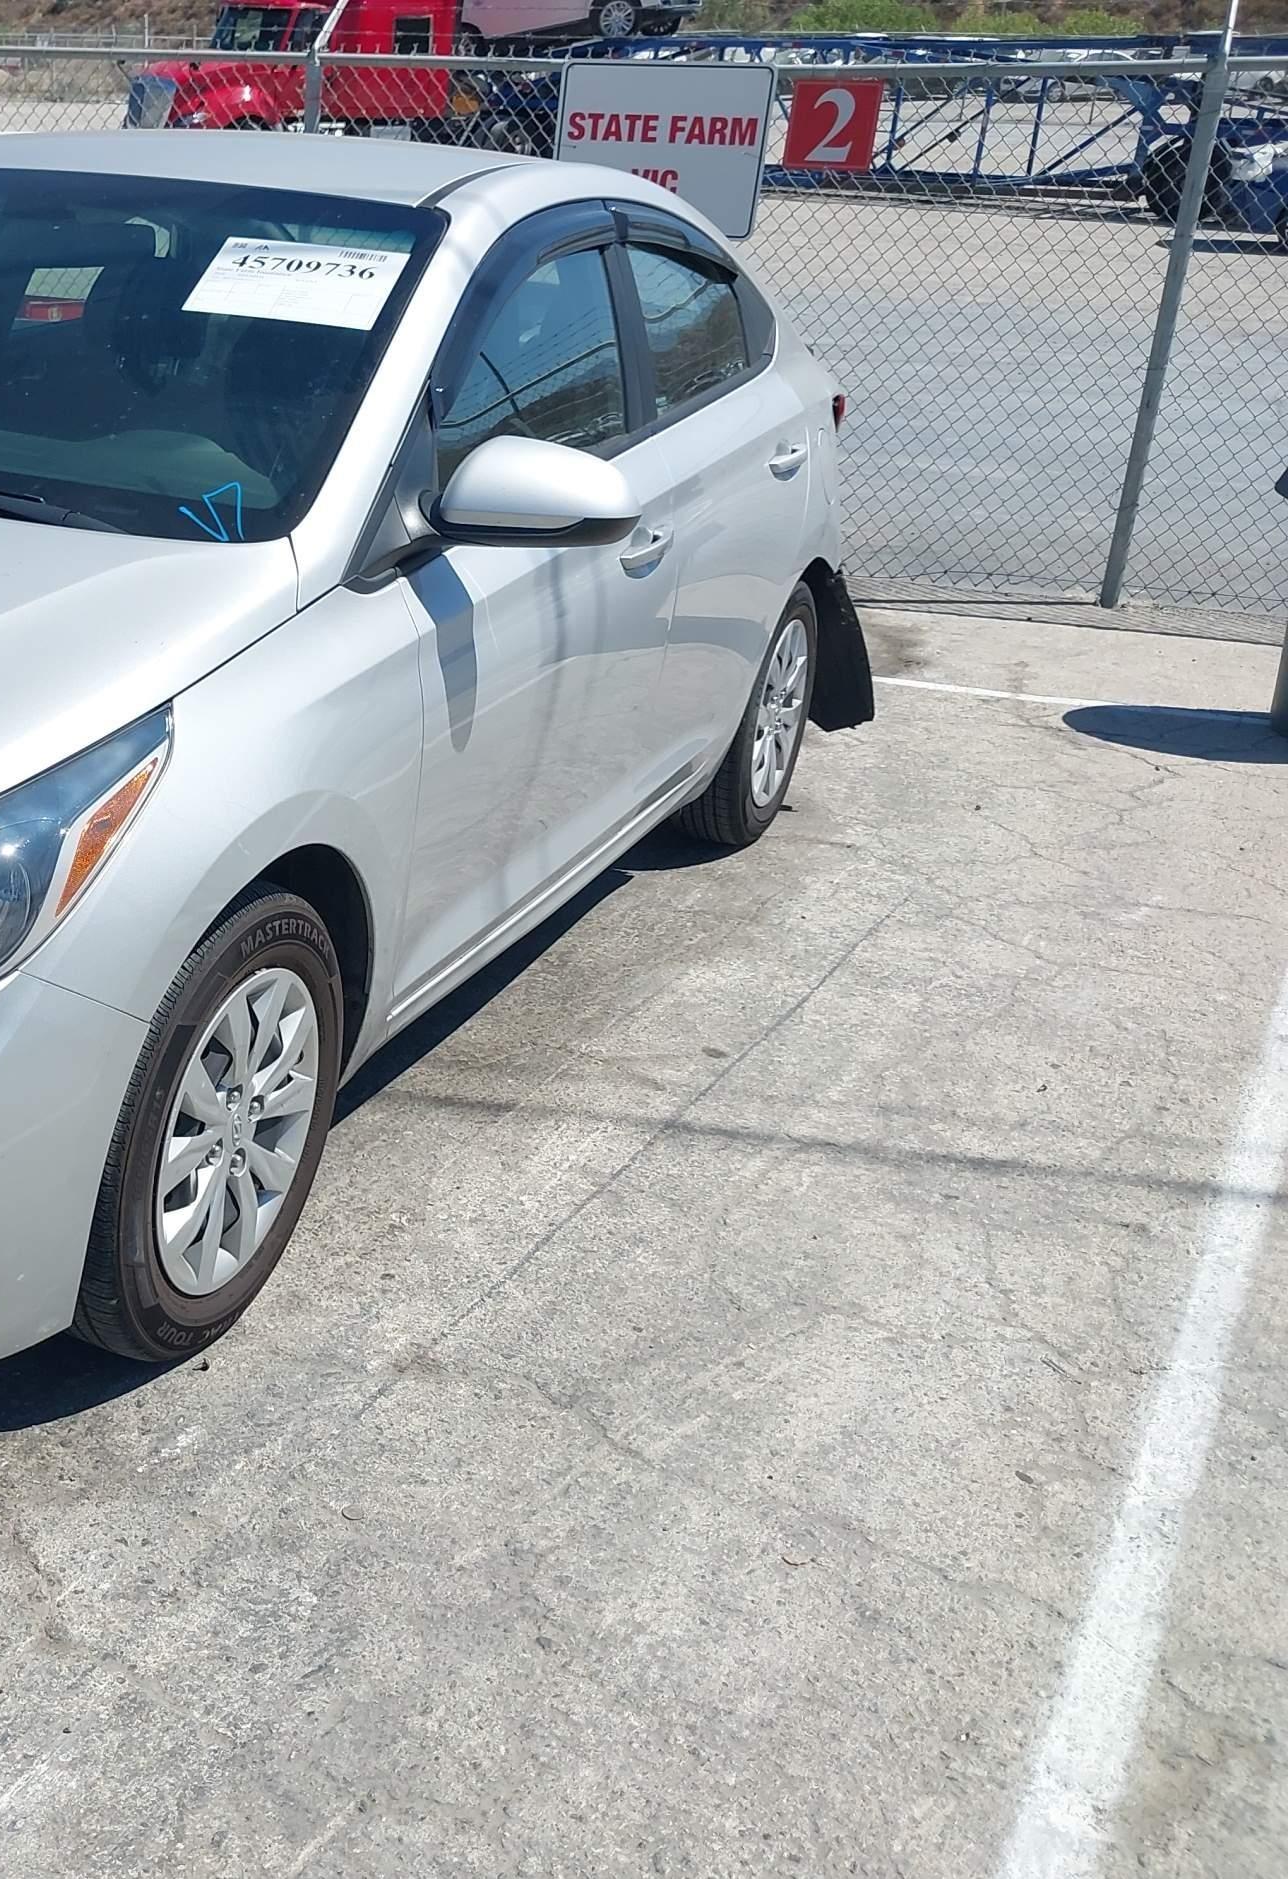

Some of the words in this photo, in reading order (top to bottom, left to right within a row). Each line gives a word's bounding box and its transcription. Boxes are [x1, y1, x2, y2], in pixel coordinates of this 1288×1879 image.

[567, 112, 660, 143] STATE
[668, 115, 759, 147] FARM
[804, 88, 856, 163] 2
[231, 253, 377, 281] 45709736
[240, 918, 330, 960] MASTERTRACK
[155, 1320, 195, 1346] TOUR
